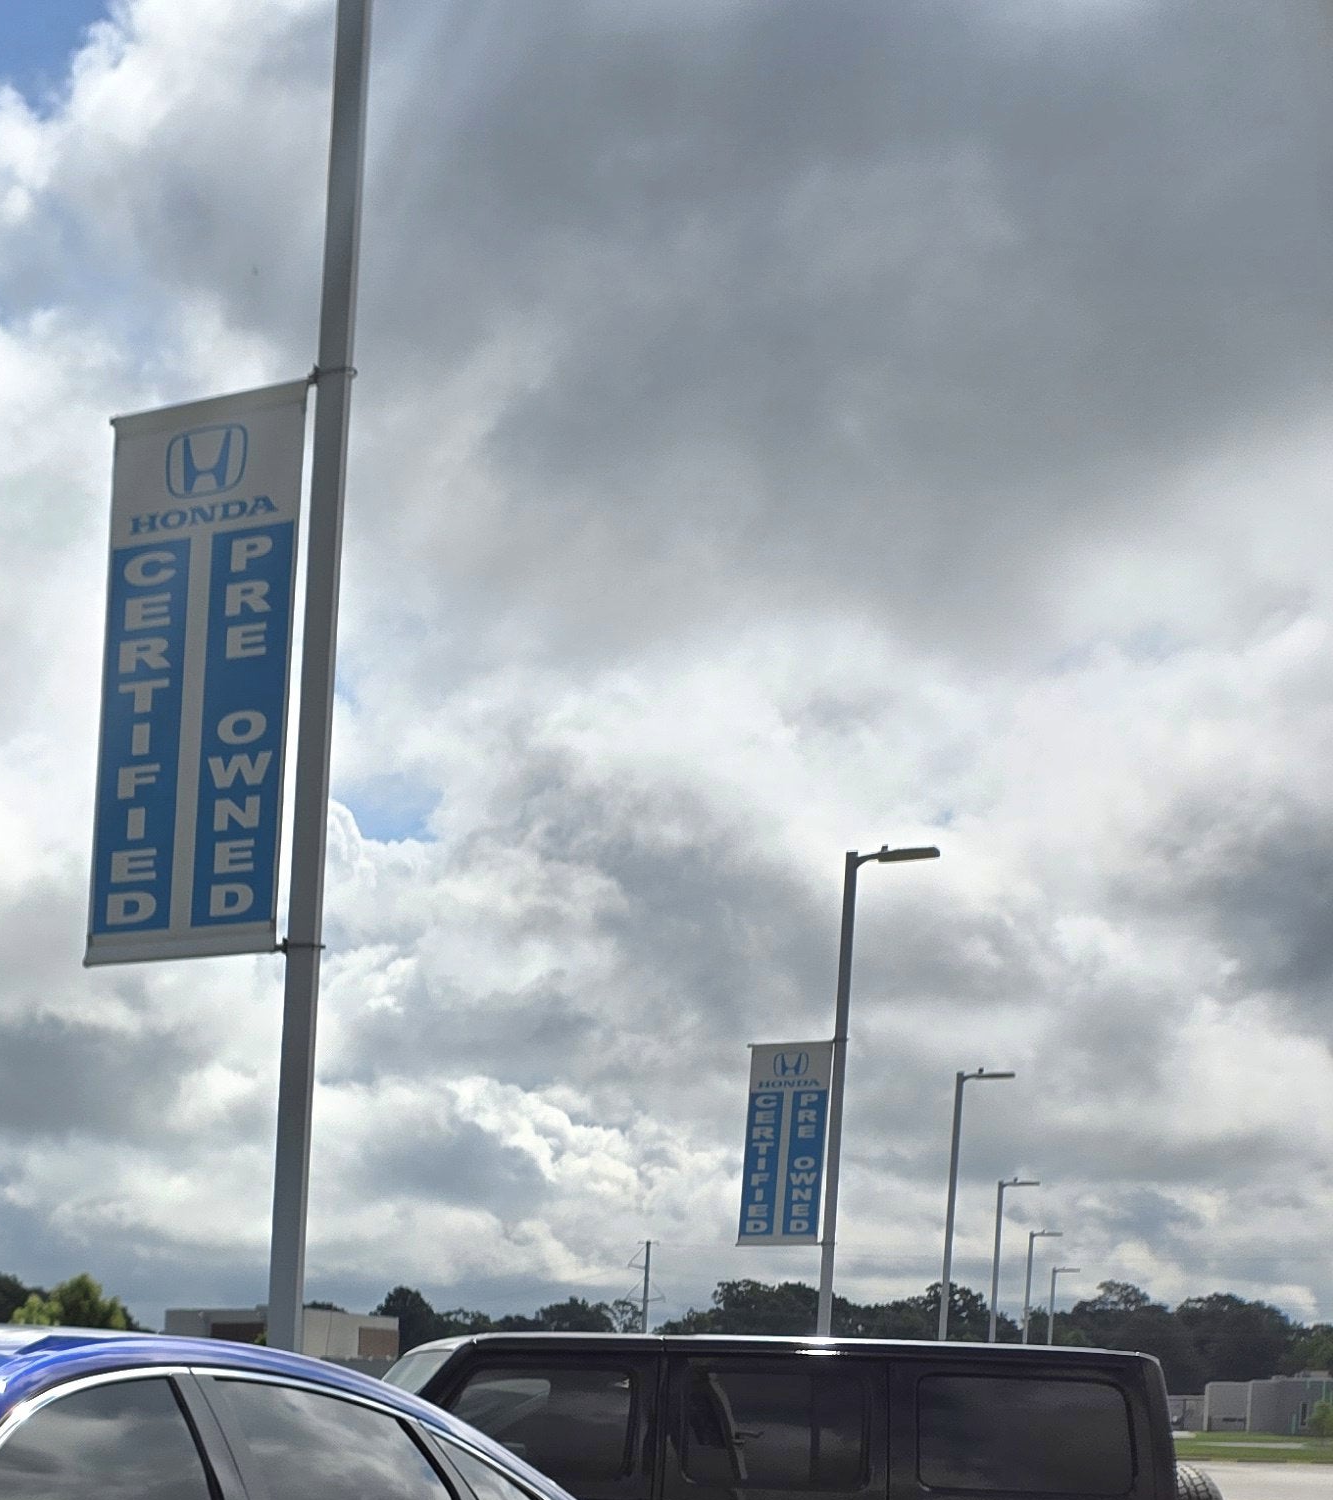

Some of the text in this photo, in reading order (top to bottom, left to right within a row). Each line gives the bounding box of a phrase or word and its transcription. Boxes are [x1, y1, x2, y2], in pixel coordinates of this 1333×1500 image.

[129, 494, 279, 534] HONDA
[105, 550, 177, 927] CERTIFIED
[208, 535, 273, 918] PRE OWNED
[758, 1078, 821, 1090] HONDA
[745, 1094, 777, 1234] CERTIFIED
[789, 1093, 819, 1233] PRE OWNED
